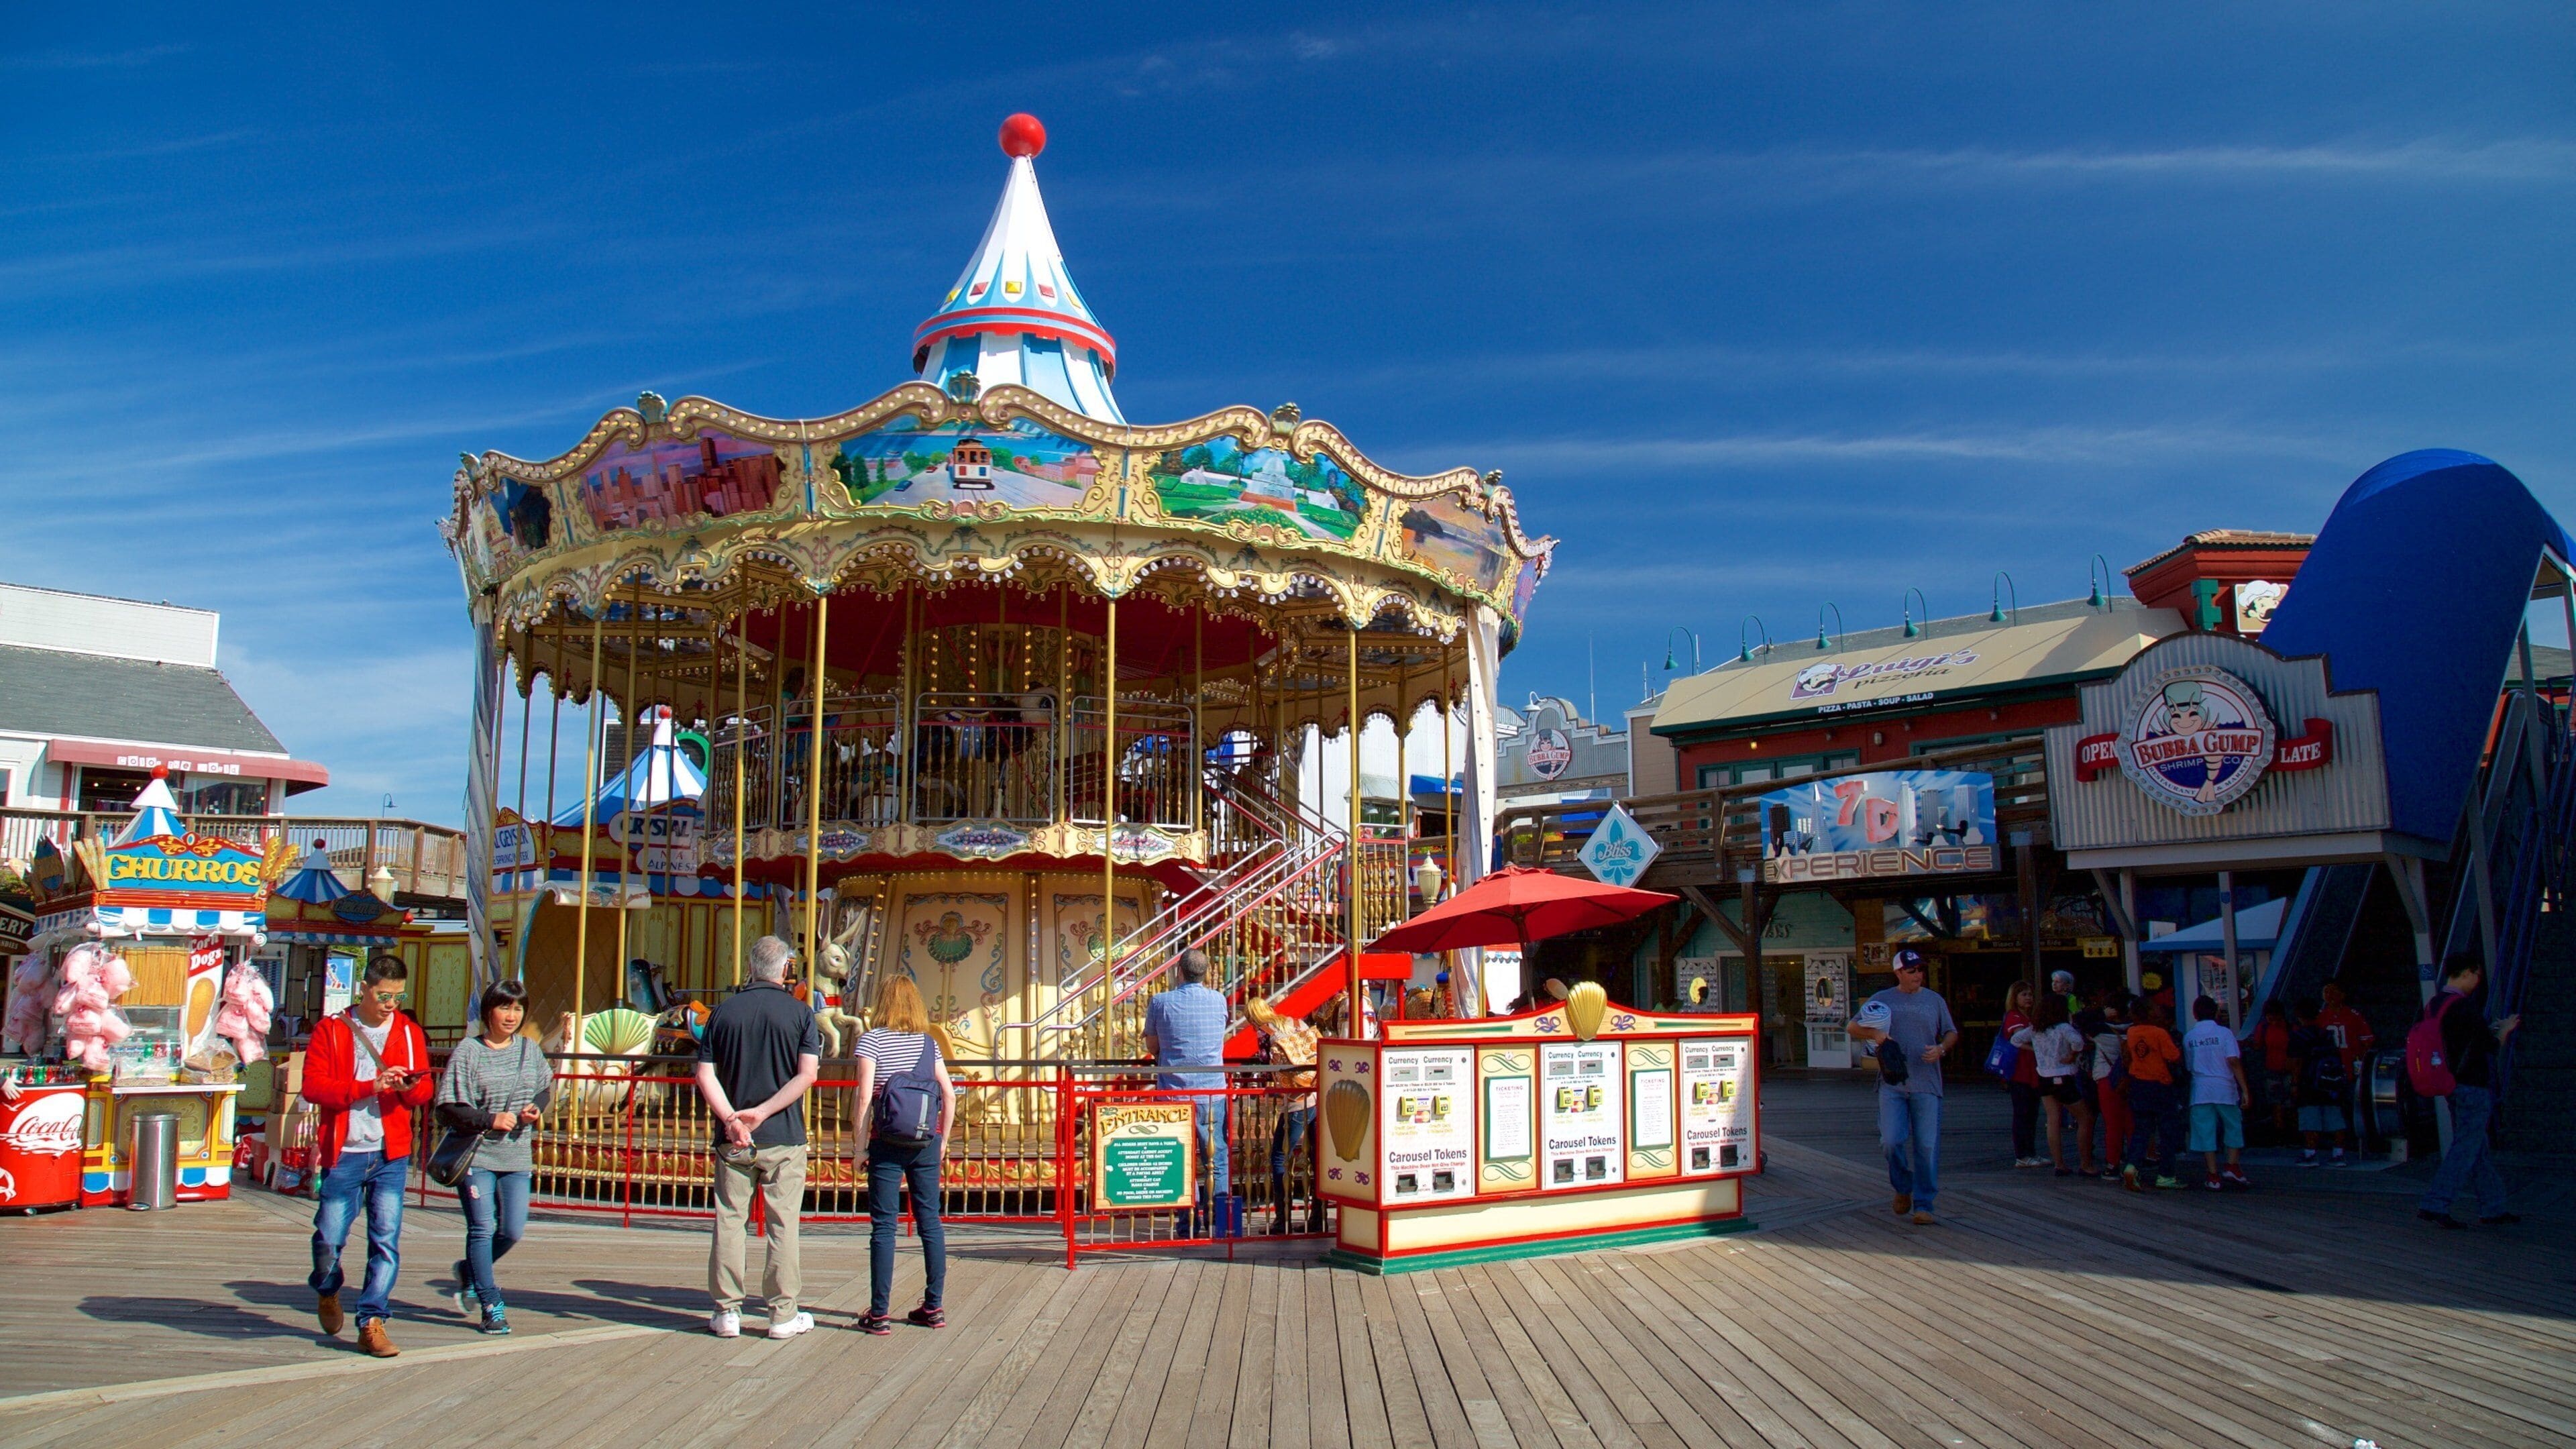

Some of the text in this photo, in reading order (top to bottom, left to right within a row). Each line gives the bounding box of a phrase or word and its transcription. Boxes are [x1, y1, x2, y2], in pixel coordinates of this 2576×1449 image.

[1838, 650, 1980, 682] Luigi's
[1854, 667, 1950, 689] pizzeria
[1818, 692, 1933, 713] PIZZA PASTA SOUP SALAD
[1529, 753, 1549, 763] BUBBA
[1551, 751, 1569, 759] GUMP
[2082, 741, 2320, 763] OPEN LATE
[2137, 732, 2259, 765] BUBBA GUMP
[2159, 758, 2204, 771] SHRIMP
[2148, 767, 2197, 795] RESTAURANT
[2224, 759, 2250, 787] MARKET
[499, 827, 529, 847] GEYSR
[513, 851, 529, 861] WTER
[1598, 842, 1633, 860] Bliss
[106, 853, 262, 886] CHURROS
[647, 859, 683, 871] ALPNE
[1764, 847, 1993, 883] EXPERIENCE
[189, 948, 221, 971] Dogs
[1389, 1056, 1453, 1065] Currency Currency
[1578, 1051, 1603, 1059] Currency
[1099, 1107, 1189, 1138] ENTRANCE
[1549, 1136, 1616, 1149] Carousel Tokens
[1687, 1127, 1748, 1140] Carousel Tokens
[1389, 1148, 1467, 1163] Carousel Tokens
